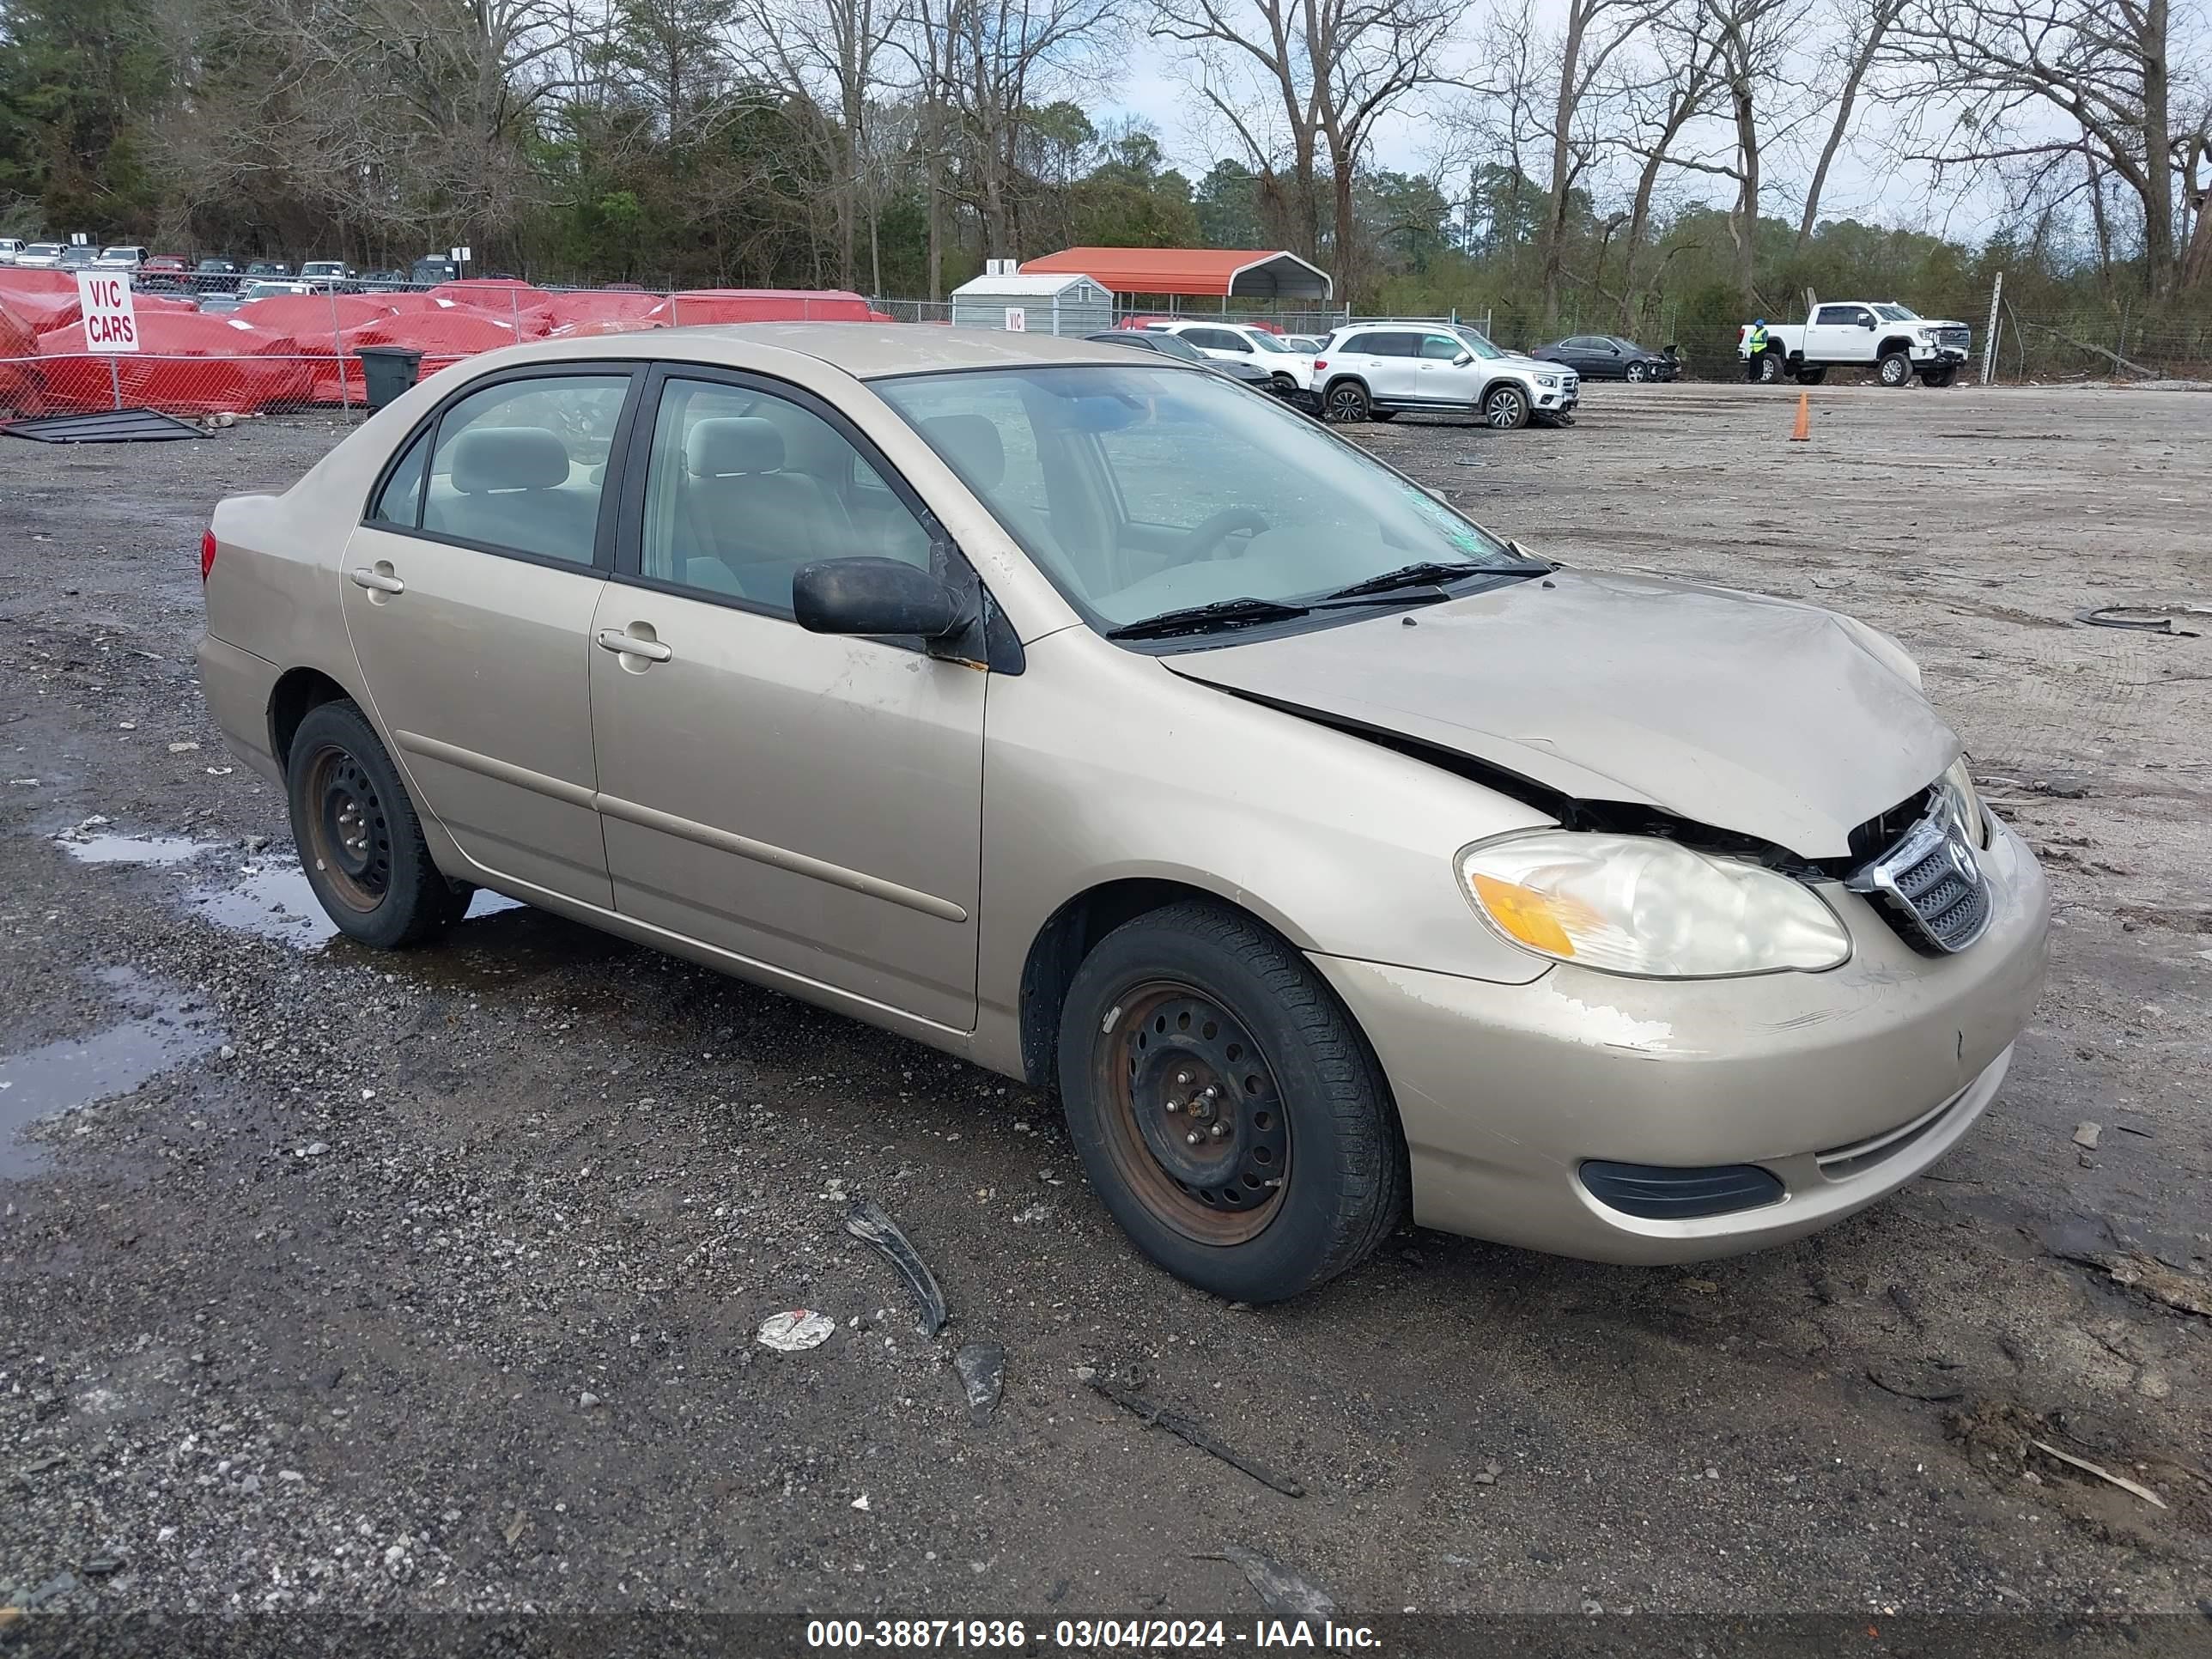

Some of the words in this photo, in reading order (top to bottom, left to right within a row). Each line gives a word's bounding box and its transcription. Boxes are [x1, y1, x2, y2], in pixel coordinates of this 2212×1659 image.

[988, 261, 997, 273] B
[1006, 260, 1015, 273] A
[88, 280, 121, 308] VIC
[88, 315, 133, 343] CARS
[1009, 313, 1022, 331] VIC
